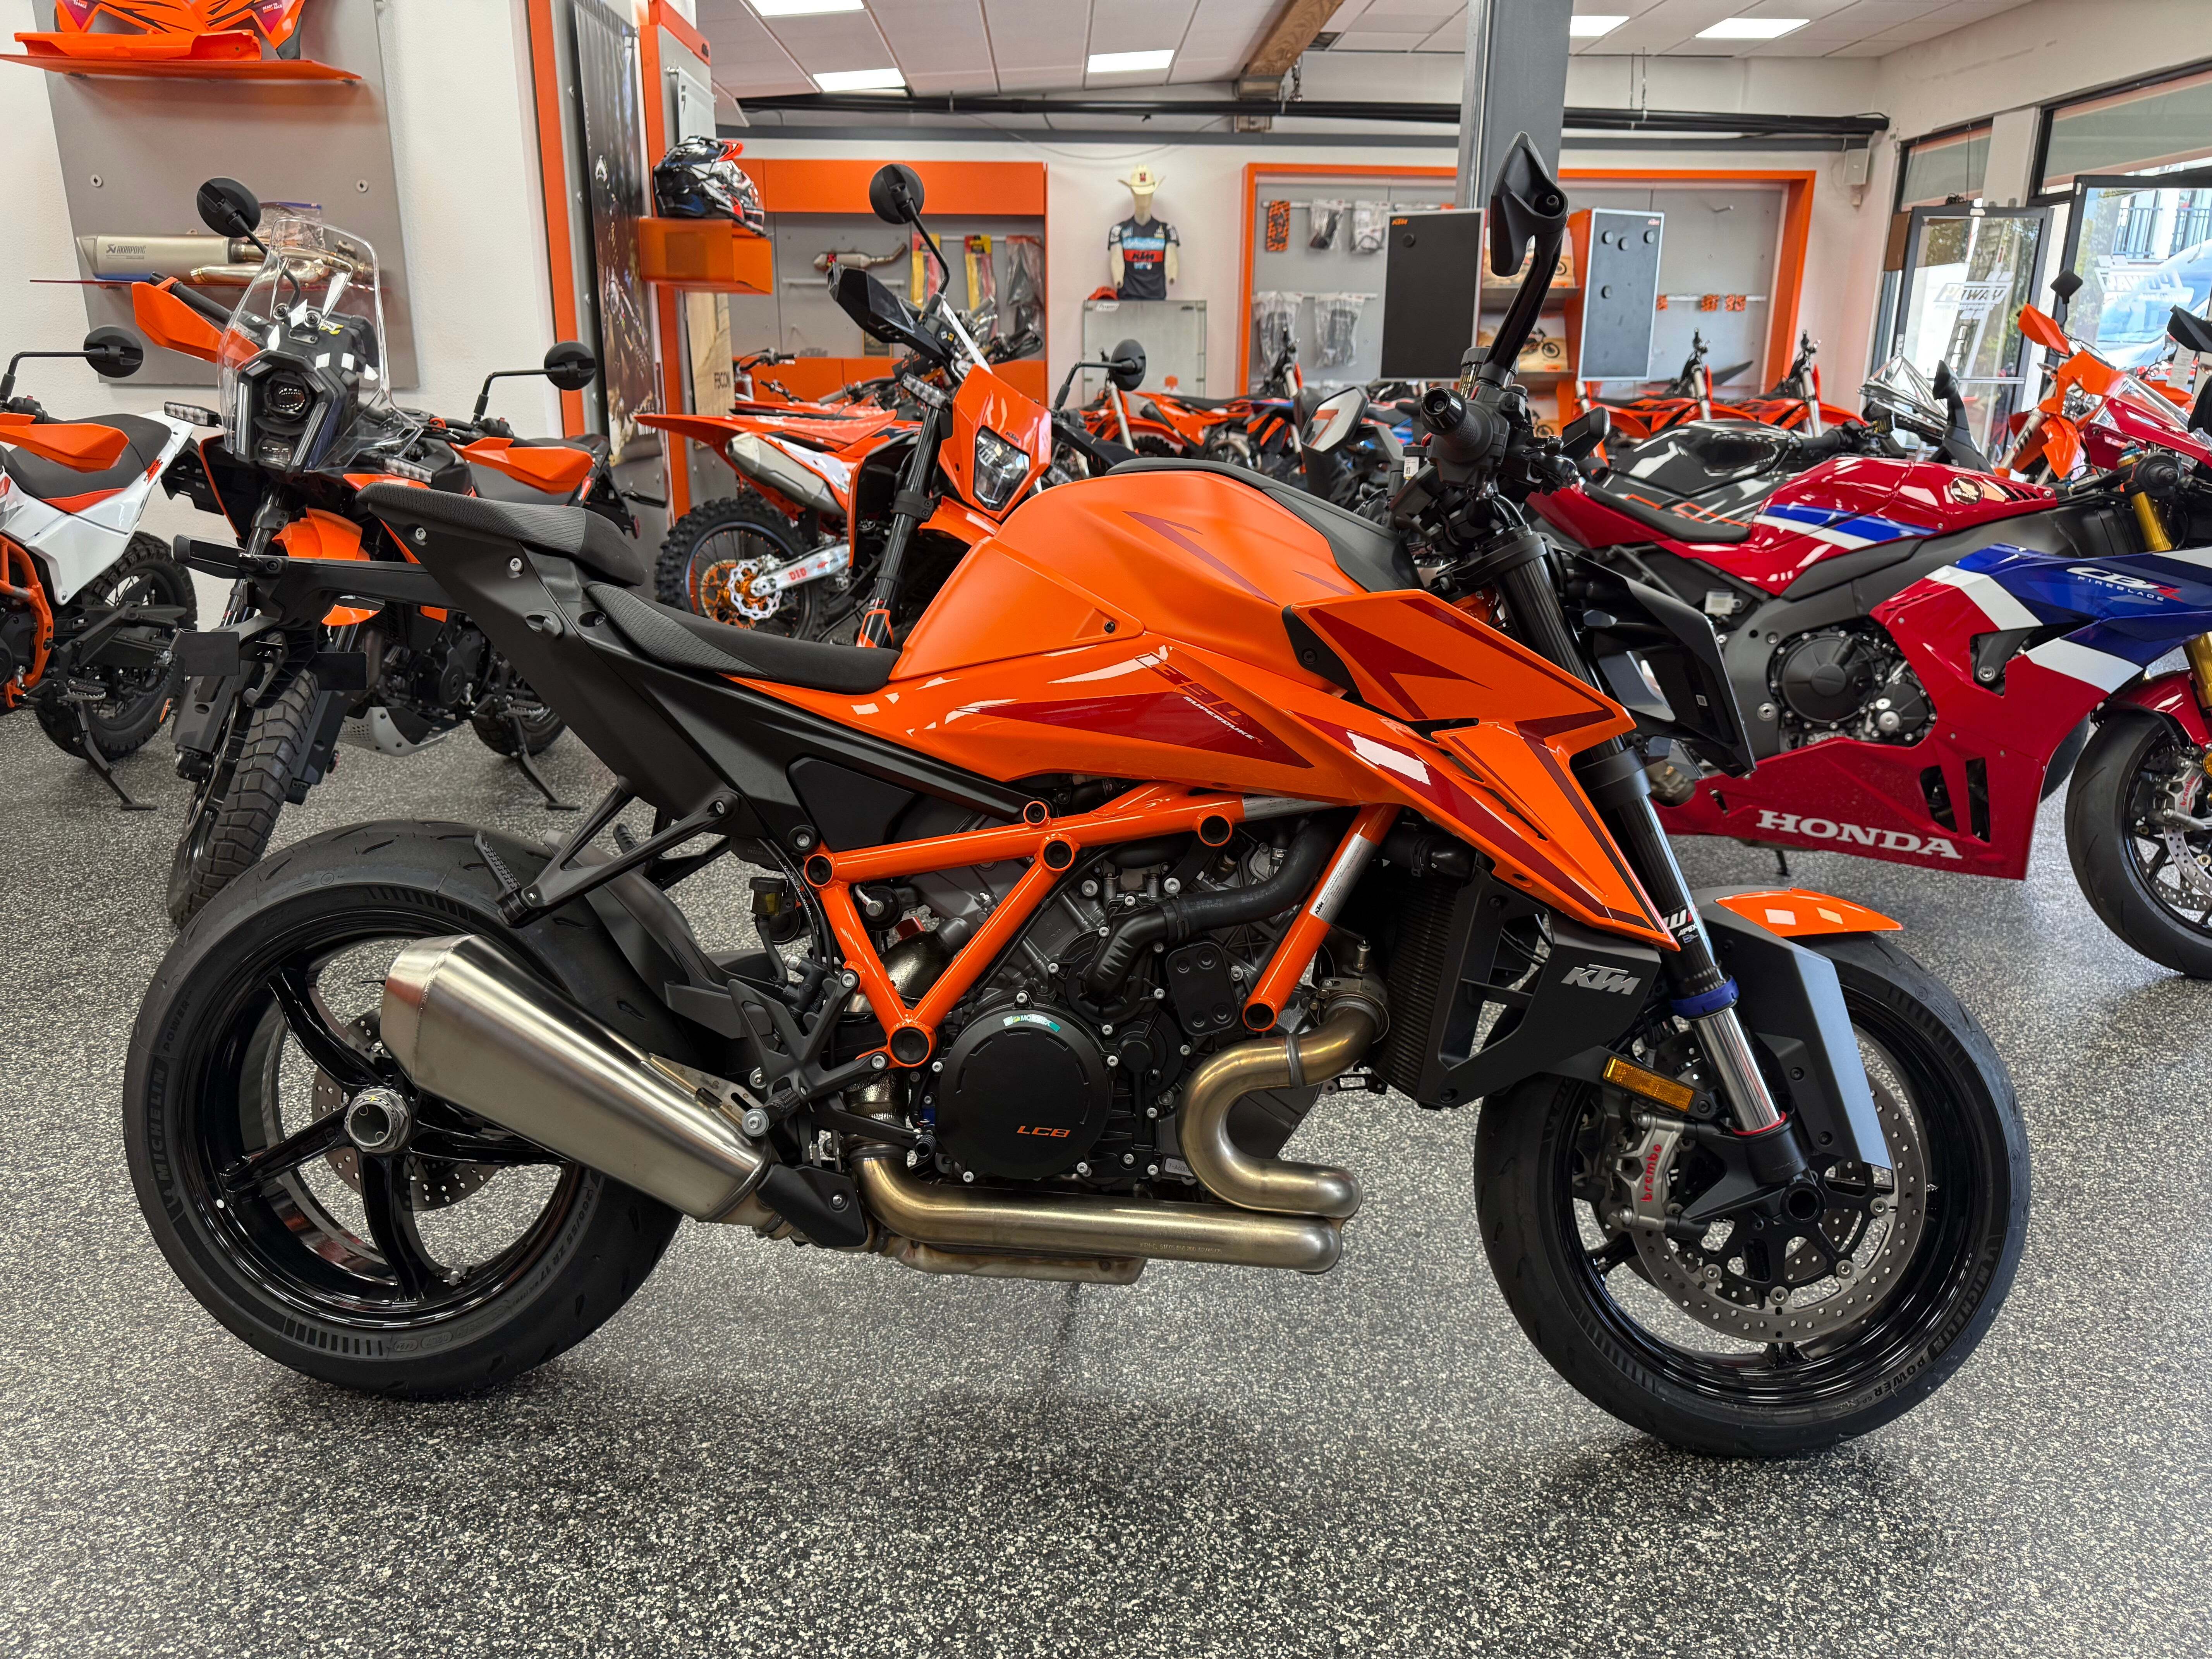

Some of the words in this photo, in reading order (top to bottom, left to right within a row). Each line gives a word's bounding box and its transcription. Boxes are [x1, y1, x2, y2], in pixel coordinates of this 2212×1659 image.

[1005, 431, 1019, 443] KTM
[788, 567, 807, 580] DID
[2077, 575, 2164, 602] FIREBLADE
[2179, 776, 2196, 806] brembo
[1755, 809, 1963, 860] HONDA
[1315, 901, 1324, 915] KTM
[1677, 923, 1698, 938] APEX
[1560, 963, 1642, 996] KTM
[160, 1000, 191, 1052] POWER
[1021, 1014, 1052, 1027] MOTOREX
[149, 1068, 170, 1183] MICHELIN
[1016, 1125, 1071, 1138] LC8
[1640, 1144, 1662, 1202] brembo
[564, 1191, 594, 1245] 200/55
[550, 1245, 568, 1266] ZR
[537, 1264, 553, 1282] 17
[1929, 1265, 1994, 1353] MICHELIN
[1871, 1356, 1929, 1397] POWER
